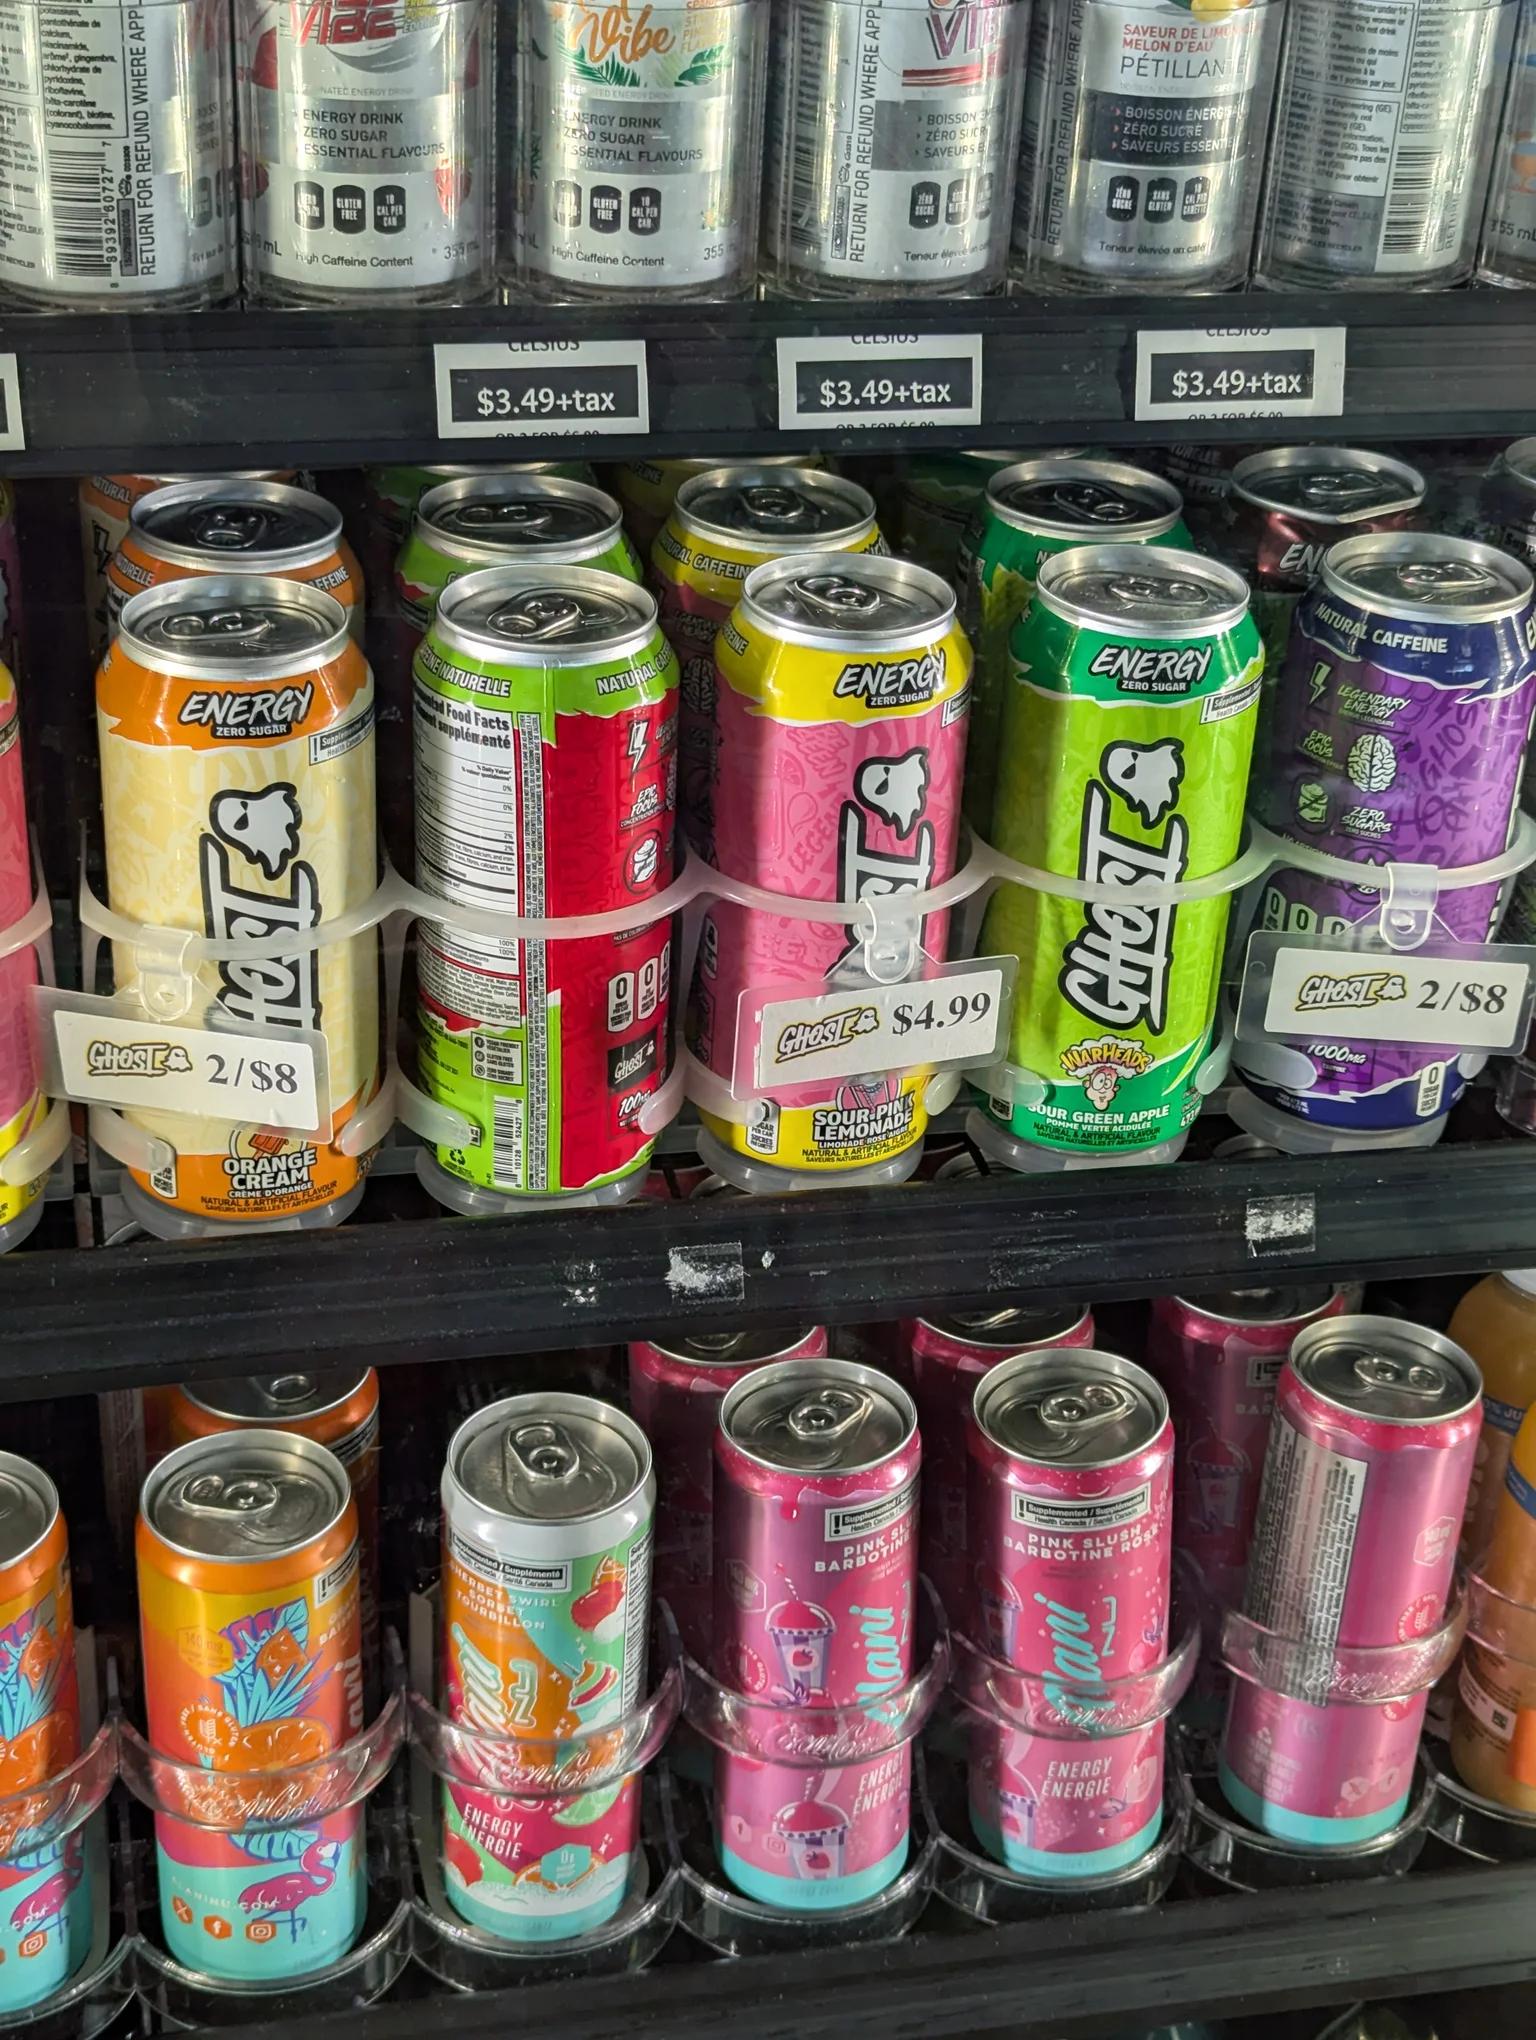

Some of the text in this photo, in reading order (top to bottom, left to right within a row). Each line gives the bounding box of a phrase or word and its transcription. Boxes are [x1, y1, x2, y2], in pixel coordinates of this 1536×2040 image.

[1123, 23, 1198, 40] SAVEUR DE
[1121, 38, 1214, 54] MELON D'EAU
[303, 109, 404, 125] ENERGY DRINK
[618, 115, 663, 130] DRINK
[926, 112, 977, 126] BOISSON
[1125, 106, 1183, 122] BOISSON
[303, 126, 388, 143] ZERO SUGAR
[599, 130, 646, 145] SUGAR
[925, 129, 957, 143] ZÉRO
[1047, 32, 1083, 247] RETURN FOR REFUND WHERE
[1123, 123, 1204, 138] ZÉRO SUCRE
[304, 142, 446, 160] ESSENTIAL FLAVOURS
[637, 148, 704, 164] FLAVOURS
[850, 43, 880, 263] RETURN FOR REFUND WHERE
[923, 147, 975, 159] SAVEURS
[1121, 138, 1180, 154] SAVEURS
[129, 46, 157, 276] RETURN FOR REFUND WHERE
[551, 246, 665, 268] High Caffeine Content
[703, 247, 725, 262] 355
[903, 250, 939, 262] Teneur
[1099, 241, 1170, 255] Teneur élevée
[321, 253, 414, 268] Caffeine Content
[819, 378, 952, 408] $3.49+tax
[1171, 368, 1303, 399] $3.49+tax
[476, 386, 616, 417] $3.49+tax
[1314, 603, 1450, 655] NATURAL CAFFEINE
[834, 649, 945, 696] ENERGY
[1090, 644, 1213, 682] ENERGY
[440, 663, 512, 697] NATURELLE
[597, 662, 656, 694] NATURAL
[1121, 680, 1187, 692] ZERO SUGAR
[178, 682, 314, 727] ENERGY
[870, 690, 930, 706] ZERO SUGAR
[1336, 684, 1412, 711] LEGENDARY
[446, 703, 473, 726] Food
[473, 710, 511, 732] Facts
[1343, 699, 1396, 719] ENERGY
[215, 725, 288, 738] ZERO SUGAR
[437, 717, 512, 750] supplémenté
[1309, 729, 1333, 746] EPIC
[1302, 739, 1333, 758] FOCUS
[637, 783, 658, 802] EPIC
[630, 794, 659, 819] FOCUS
[1351, 806, 1385, 823] ZERO
[1340, 815, 1393, 834] SUGARS
[1269, 892, 1281, 911] 0
[1296, 907, 1309, 931] 0
[499, 940, 516, 948] 100%
[499, 948, 516, 957] 100%
[644, 963, 654, 986] 0
[615, 977, 629, 1000] 0
[1294, 972, 1508, 1015] GHOST 2/$8
[774, 991, 992, 1064] GHOST $4.99
[88, 1041, 299, 1095] GHOST 2/$8
[614, 1043, 649, 1085] GHOST
[1060, 1043, 1152, 1073] WARHEADS
[1427, 1065, 1439, 1085] 0
[876, 1092, 915, 1121] PINK
[1027, 1102, 1171, 1125] SOUR GREEN APPLE
[813, 1108, 914, 1142] LEMONADE
[1033, 1121, 1161, 1141] NATURAL ARTIFICIAL FLAVOUR
[1045, 1117, 1152, 1133] POMME VERTE ACIDULÉE
[801, 1127, 918, 1158] NATURAL ARTIFICIAL FLAVOUR
[818, 1135, 887, 1150] LIMONADE ROSE
[1036, 1130, 1065, 1143] SAVEURS
[1066, 1136, 1107, 1147] NATURELLES
[222, 1147, 318, 1176] ORANGE
[231, 1166, 310, 1191] CREAM
[201, 1180, 338, 1207] NATURAL ARTIFICIAL FLAVOUR
[228, 1182, 314, 1199] CRÈME D'ORANGE
[205, 1204, 236, 1213] SAVEURS
[237, 1203, 281, 1214] NATURELLES
[844, 1499, 896, 1524] Supplemented
[1028, 1493, 1144, 1518] Supplemented Supplémenté
[850, 1520, 873, 1533] Health
[1034, 1507, 1138, 1527] Health Canada Santé Canada
[844, 1534, 886, 1558] PINK
[1028, 1523, 1142, 1550] PINK SLUSH
[814, 1531, 910, 1573] BARBOTINE
[1003, 1534, 1113, 1562] BARBOTINE
[502, 1573, 553, 1588] Santé Canada
[504, 1565, 561, 1579] Supplémenté
[456, 1590, 545, 1630] TOURBILLON
[468, 1589, 525, 1617] SORBET
[509, 1595, 560, 1608] SWIRL
[1047, 1756, 1112, 1780] ENERGY
[1041, 1776, 1112, 1799] ÉNERGIE
[463, 1802, 525, 1840] ENERGY
[460, 1816, 522, 1860] ÉNERGIE
